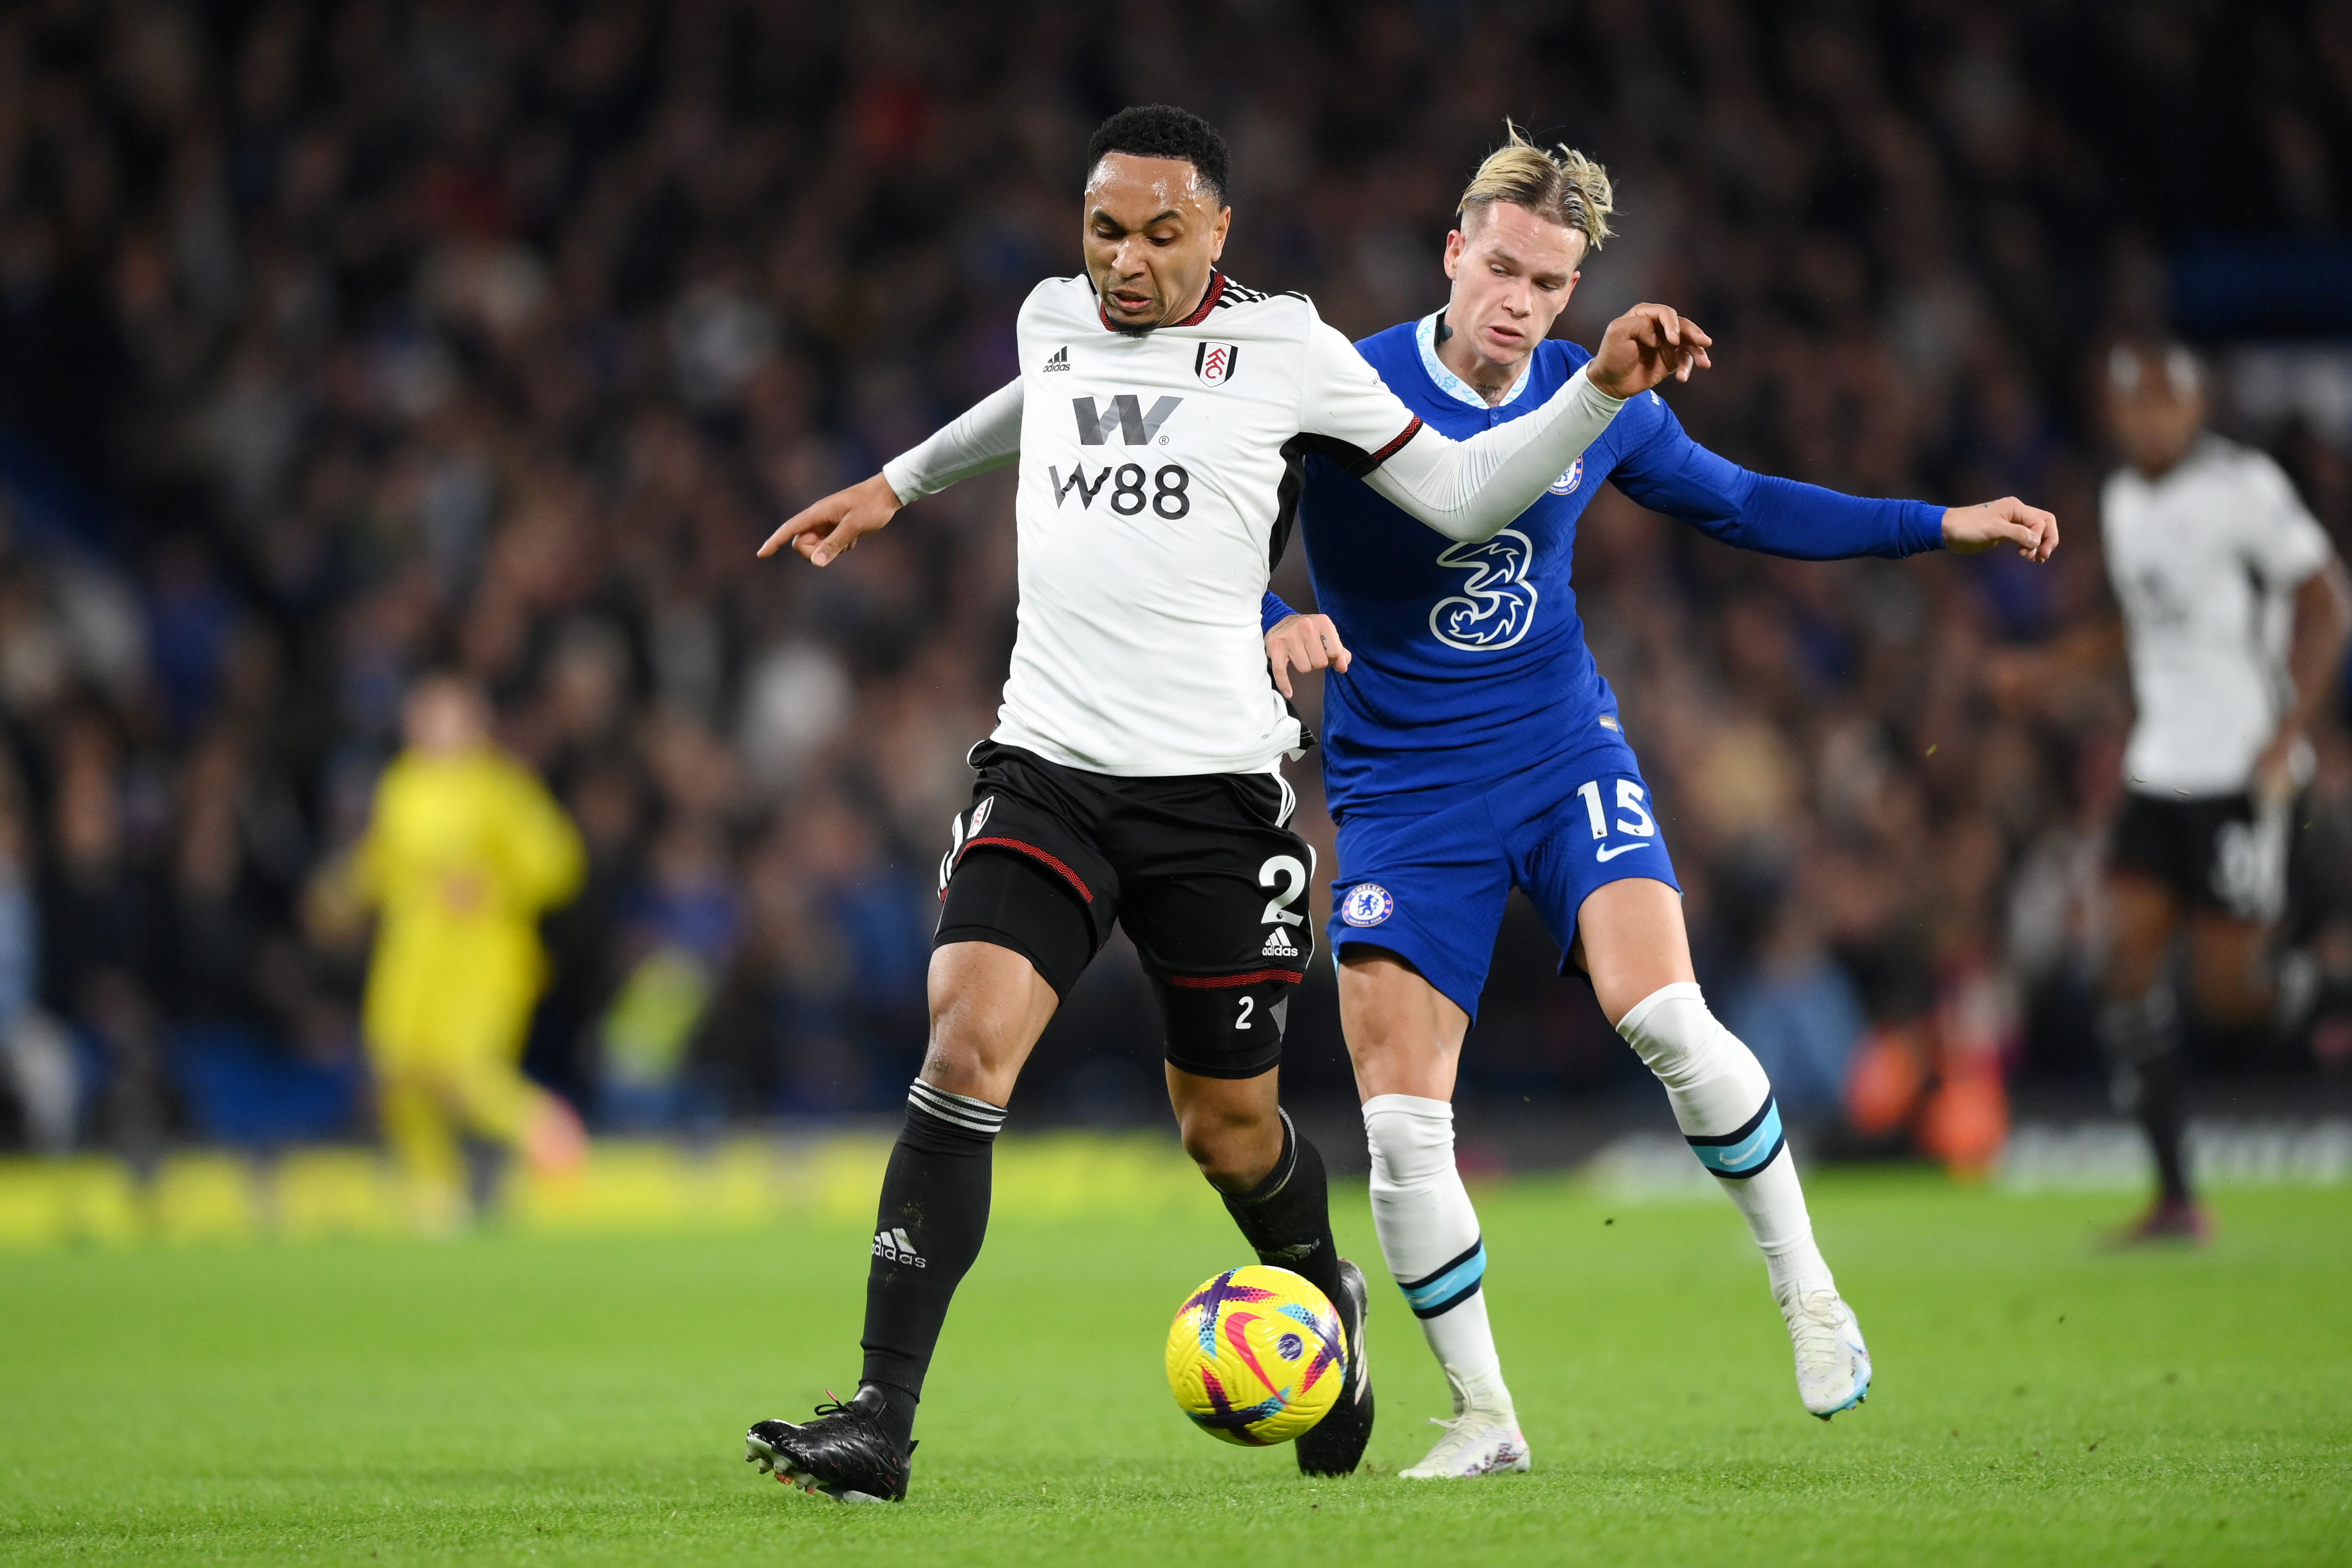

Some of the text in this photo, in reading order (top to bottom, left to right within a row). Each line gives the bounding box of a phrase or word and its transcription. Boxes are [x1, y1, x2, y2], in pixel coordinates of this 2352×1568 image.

[1043, 362, 1071, 373] adidas
[1048, 461, 1190, 520] W88
[1429, 528, 1538, 652] 3
[1577, 779, 1655, 840] 15
[1258, 855, 1306, 927] 2
[1352, 885, 1385, 896] CHELSEA
[1262, 944, 1299, 957] adidas
[1235, 996, 1254, 1030] 2
[871, 1241, 926, 1269] adidas
